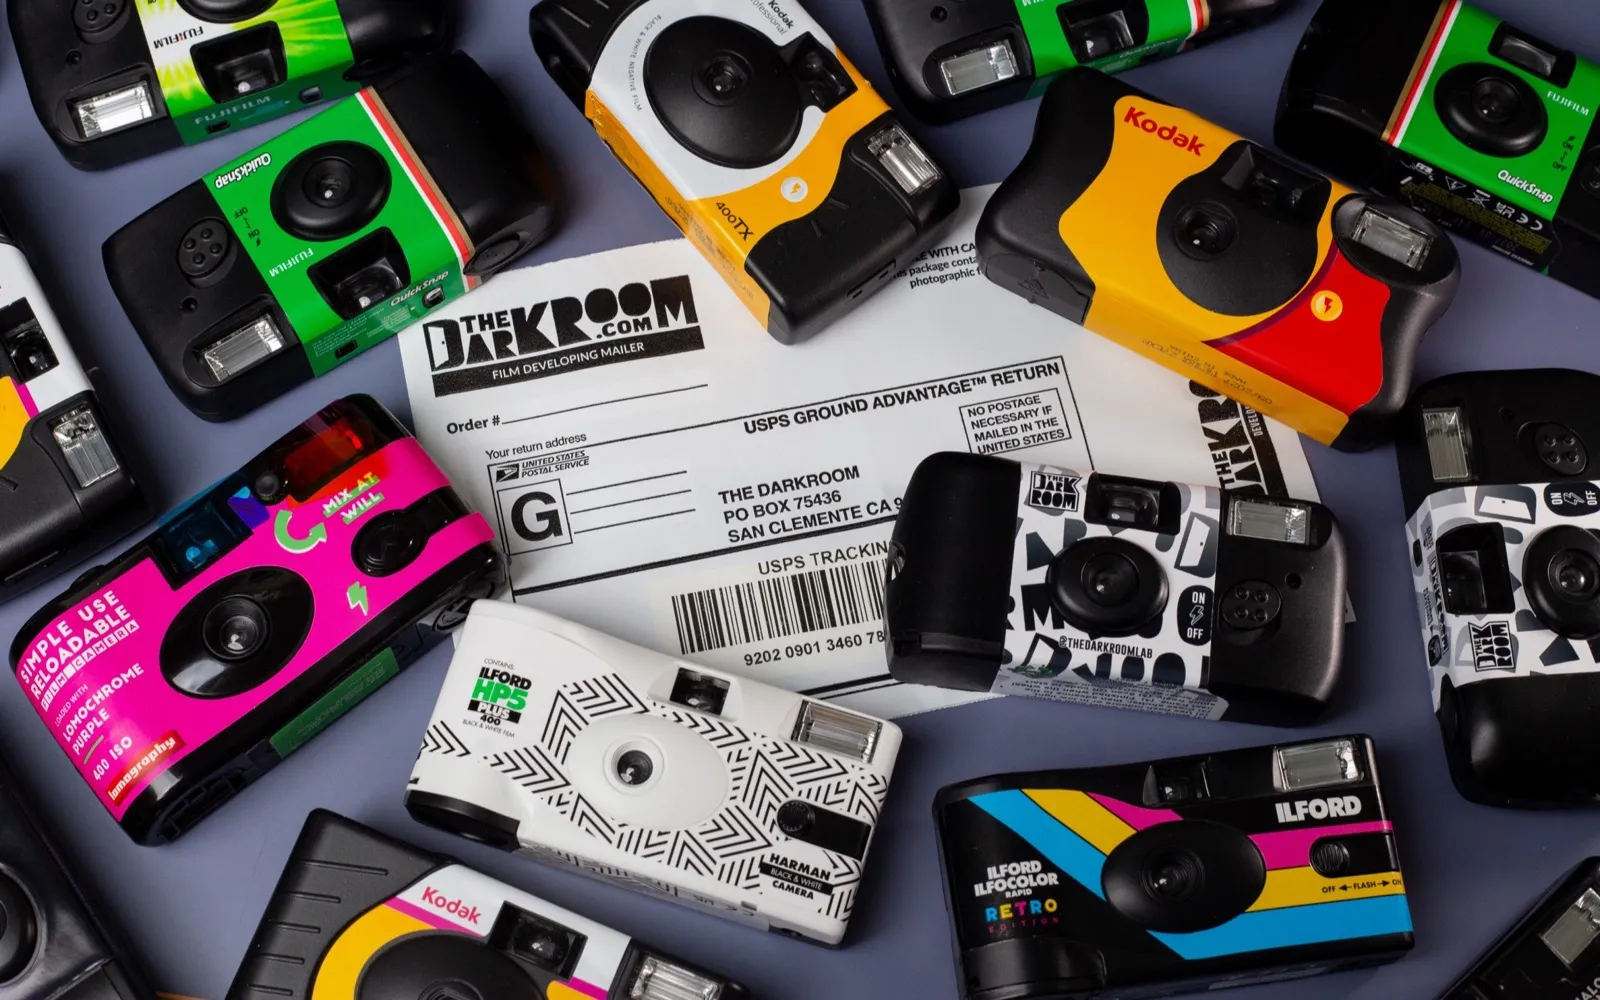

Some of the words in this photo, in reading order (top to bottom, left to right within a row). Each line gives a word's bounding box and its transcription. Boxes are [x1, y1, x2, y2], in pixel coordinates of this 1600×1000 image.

[645, 14, 662, 32] BLACK
[752, 0, 788, 35] ofessional
[768, 0, 794, 29] Kodak
[153, 26, 204, 49] FUJIFILM
[629, 37, 643, 59] WHITE
[627, 61, 637, 92] NEGATIVE
[632, 94, 643, 112] FILM
[1546, 90, 1590, 117] FUJIFILM
[1123, 106, 1205, 157] Kodak
[1562, 140, 1574, 150] ON
[214, 152, 272, 189] QuickSnap
[1552, 161, 1568, 172] OFF
[1497, 169, 1554, 204] QuickSnap
[233, 206, 249, 219] OFF
[715, 201, 755, 242] 400TX
[247, 228, 260, 239] ON
[268, 247, 315, 278] FUJIFILM
[928, 245, 959, 259] WITH
[961, 242, 976, 253] CA
[909, 262, 949, 277] package
[951, 256, 976, 267] cont
[910, 268, 975, 289] photographic
[390, 270, 449, 307] QuickSnap
[422, 274, 699, 373] DARKROOM
[459, 310, 511, 334] THE
[596, 316, 652, 339] .COM
[492, 366, 520, 380] FILM
[523, 350, 599, 374] DEVELOPING
[601, 342, 645, 358] MAILER
[744, 414, 790, 434] USPS
[793, 399, 868, 424] GROUND
[991, 362, 1060, 387] RETURN
[967, 406, 985, 418] NO
[988, 395, 1042, 414] POSTAGE
[446, 418, 488, 434] Order
[492, 415, 500, 426] #
[971, 408, 1040, 430] NECESSARY
[1042, 405, 1053, 415] IF
[974, 425, 1018, 442] MAILED
[1021, 422, 1033, 433] IN
[1035, 417, 1059, 430] THE
[1245, 405, 1263, 437] DEVELO
[485, 448, 509, 460] Your
[512, 442, 543, 456] return
[545, 433, 587, 448] address
[977, 437, 1021, 455] UNITED
[1022, 428, 1065, 446] STATES
[521, 466, 554, 478] POSTAL
[555, 458, 590, 471] SERVICE
[522, 456, 555, 469] UNITED
[556, 450, 585, 462] STATES
[1211, 451, 1235, 489] THE
[322, 488, 353, 513] MIX
[357, 471, 376, 491] AT
[718, 486, 755, 504] THE
[757, 465, 860, 497] DARKROOM
[1033, 473, 1078, 494] DARK
[340, 492, 380, 519] WILL
[723, 507, 749, 524] PO
[753, 498, 791, 518] BOX
[793, 490, 842, 510] 75436
[1031, 490, 1076, 509] ROOM
[1550, 492, 1563, 505] ON
[1585, 490, 1598, 506] OFF
[511, 491, 563, 541] G
[728, 524, 765, 543] SAN
[769, 505, 863, 535] CLEMENTE
[866, 499, 892, 516] CA
[758, 556, 806, 575] USPS
[809, 540, 888, 566] TRACKIN
[1192, 591, 1206, 605] ON
[20, 620, 73, 684] SIMPLE
[77, 590, 119, 621] USE
[1186, 627, 1204, 639] OFF
[1491, 624, 1513, 667] ROOM
[30, 604, 131, 700] RELOADABLE
[744, 649, 781, 666] 9202
[785, 641, 821, 659] 0901
[826, 634, 862, 651] 3460
[866, 630, 885, 645] 78
[1058, 635, 1153, 659] @THEDARKROOMLAB
[1472, 624, 1497, 669] DARK
[1474, 640, 1483, 655] THE
[41, 672, 67, 712] FILM
[72, 619, 140, 672] CAMERA
[483, 658, 515, 670] CONTAINS
[478, 666, 532, 691] ILFORD
[55, 701, 72, 728] LOADED
[70, 684, 89, 703] WITH
[62, 662, 145, 743] LOMOCHROME
[471, 678, 529, 711] HP5
[477, 702, 510, 719] PLUS
[480, 714, 501, 726] 400
[72, 708, 110, 756] PURPLE
[462, 719, 478, 728] BLACK
[485, 725, 502, 734] WHITE
[502, 730, 516, 738] FILM
[92, 758, 110, 781] 400
[108, 736, 133, 761] ISO
[107, 736, 177, 801] lomography
[1275, 795, 1362, 823] ILFORD
[769, 852, 831, 881] HARMAN
[987, 860, 1042, 880] ILFORD
[771, 868, 793, 881] BLACK
[801, 877, 823, 891] WHITE
[772, 880, 814, 900] CAMERA
[974, 872, 1059, 897] ILFOCOLOR
[1322, 885, 1336, 894] OFF
[1353, 881, 1377, 890] FLASH
[421, 886, 482, 926] Kodak
[1005, 888, 1033, 899] RAPID
[985, 898, 1058, 923] RETRO
[988, 917, 1060, 935] EDITION
